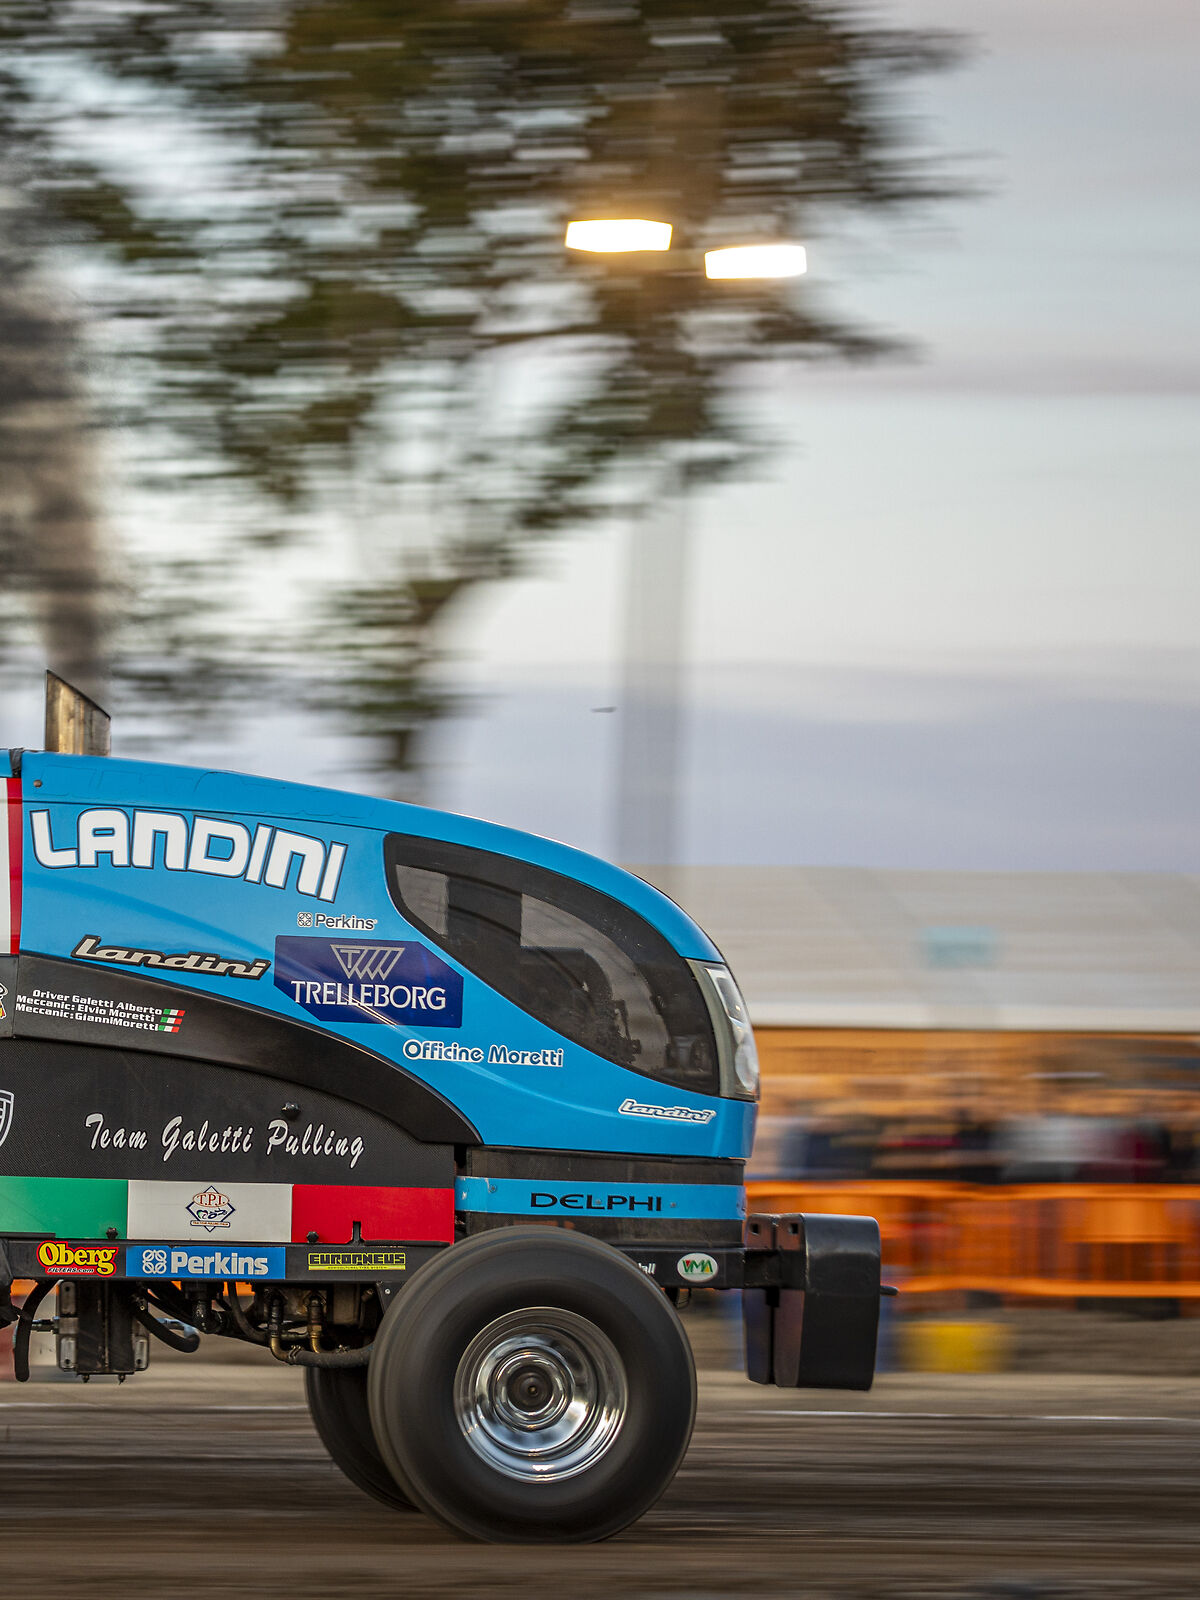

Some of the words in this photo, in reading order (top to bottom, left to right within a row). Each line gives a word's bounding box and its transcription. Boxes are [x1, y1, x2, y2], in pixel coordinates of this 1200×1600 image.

[30, 807, 349, 904] LANDINI
[315, 913, 375, 930] Perkins
[73, 936, 270, 980] Landini
[16, 994, 75, 1011] Meccanic:
[77, 1004, 107, 1016] Elvio
[108, 1008, 155, 1023] Moretti
[32, 989, 70, 1002] Driver
[72, 994, 114, 1008] Galetti
[116, 1001, 163, 1016] Alberto
[290, 980, 447, 1011] TRELLEBORG
[404, 1040, 484, 1062] Officine
[488, 1045, 563, 1066] Moretti
[619, 1099, 715, 1124] Landini
[84, 1113, 148, 1150] Team
[161, 1115, 254, 1162] Galetti
[266, 1119, 364, 1169] Pulling
[530, 1192, 662, 1212] DELPHI
[38, 1242, 116, 1275] Oberg
[170, 1251, 269, 1275] Perkins
